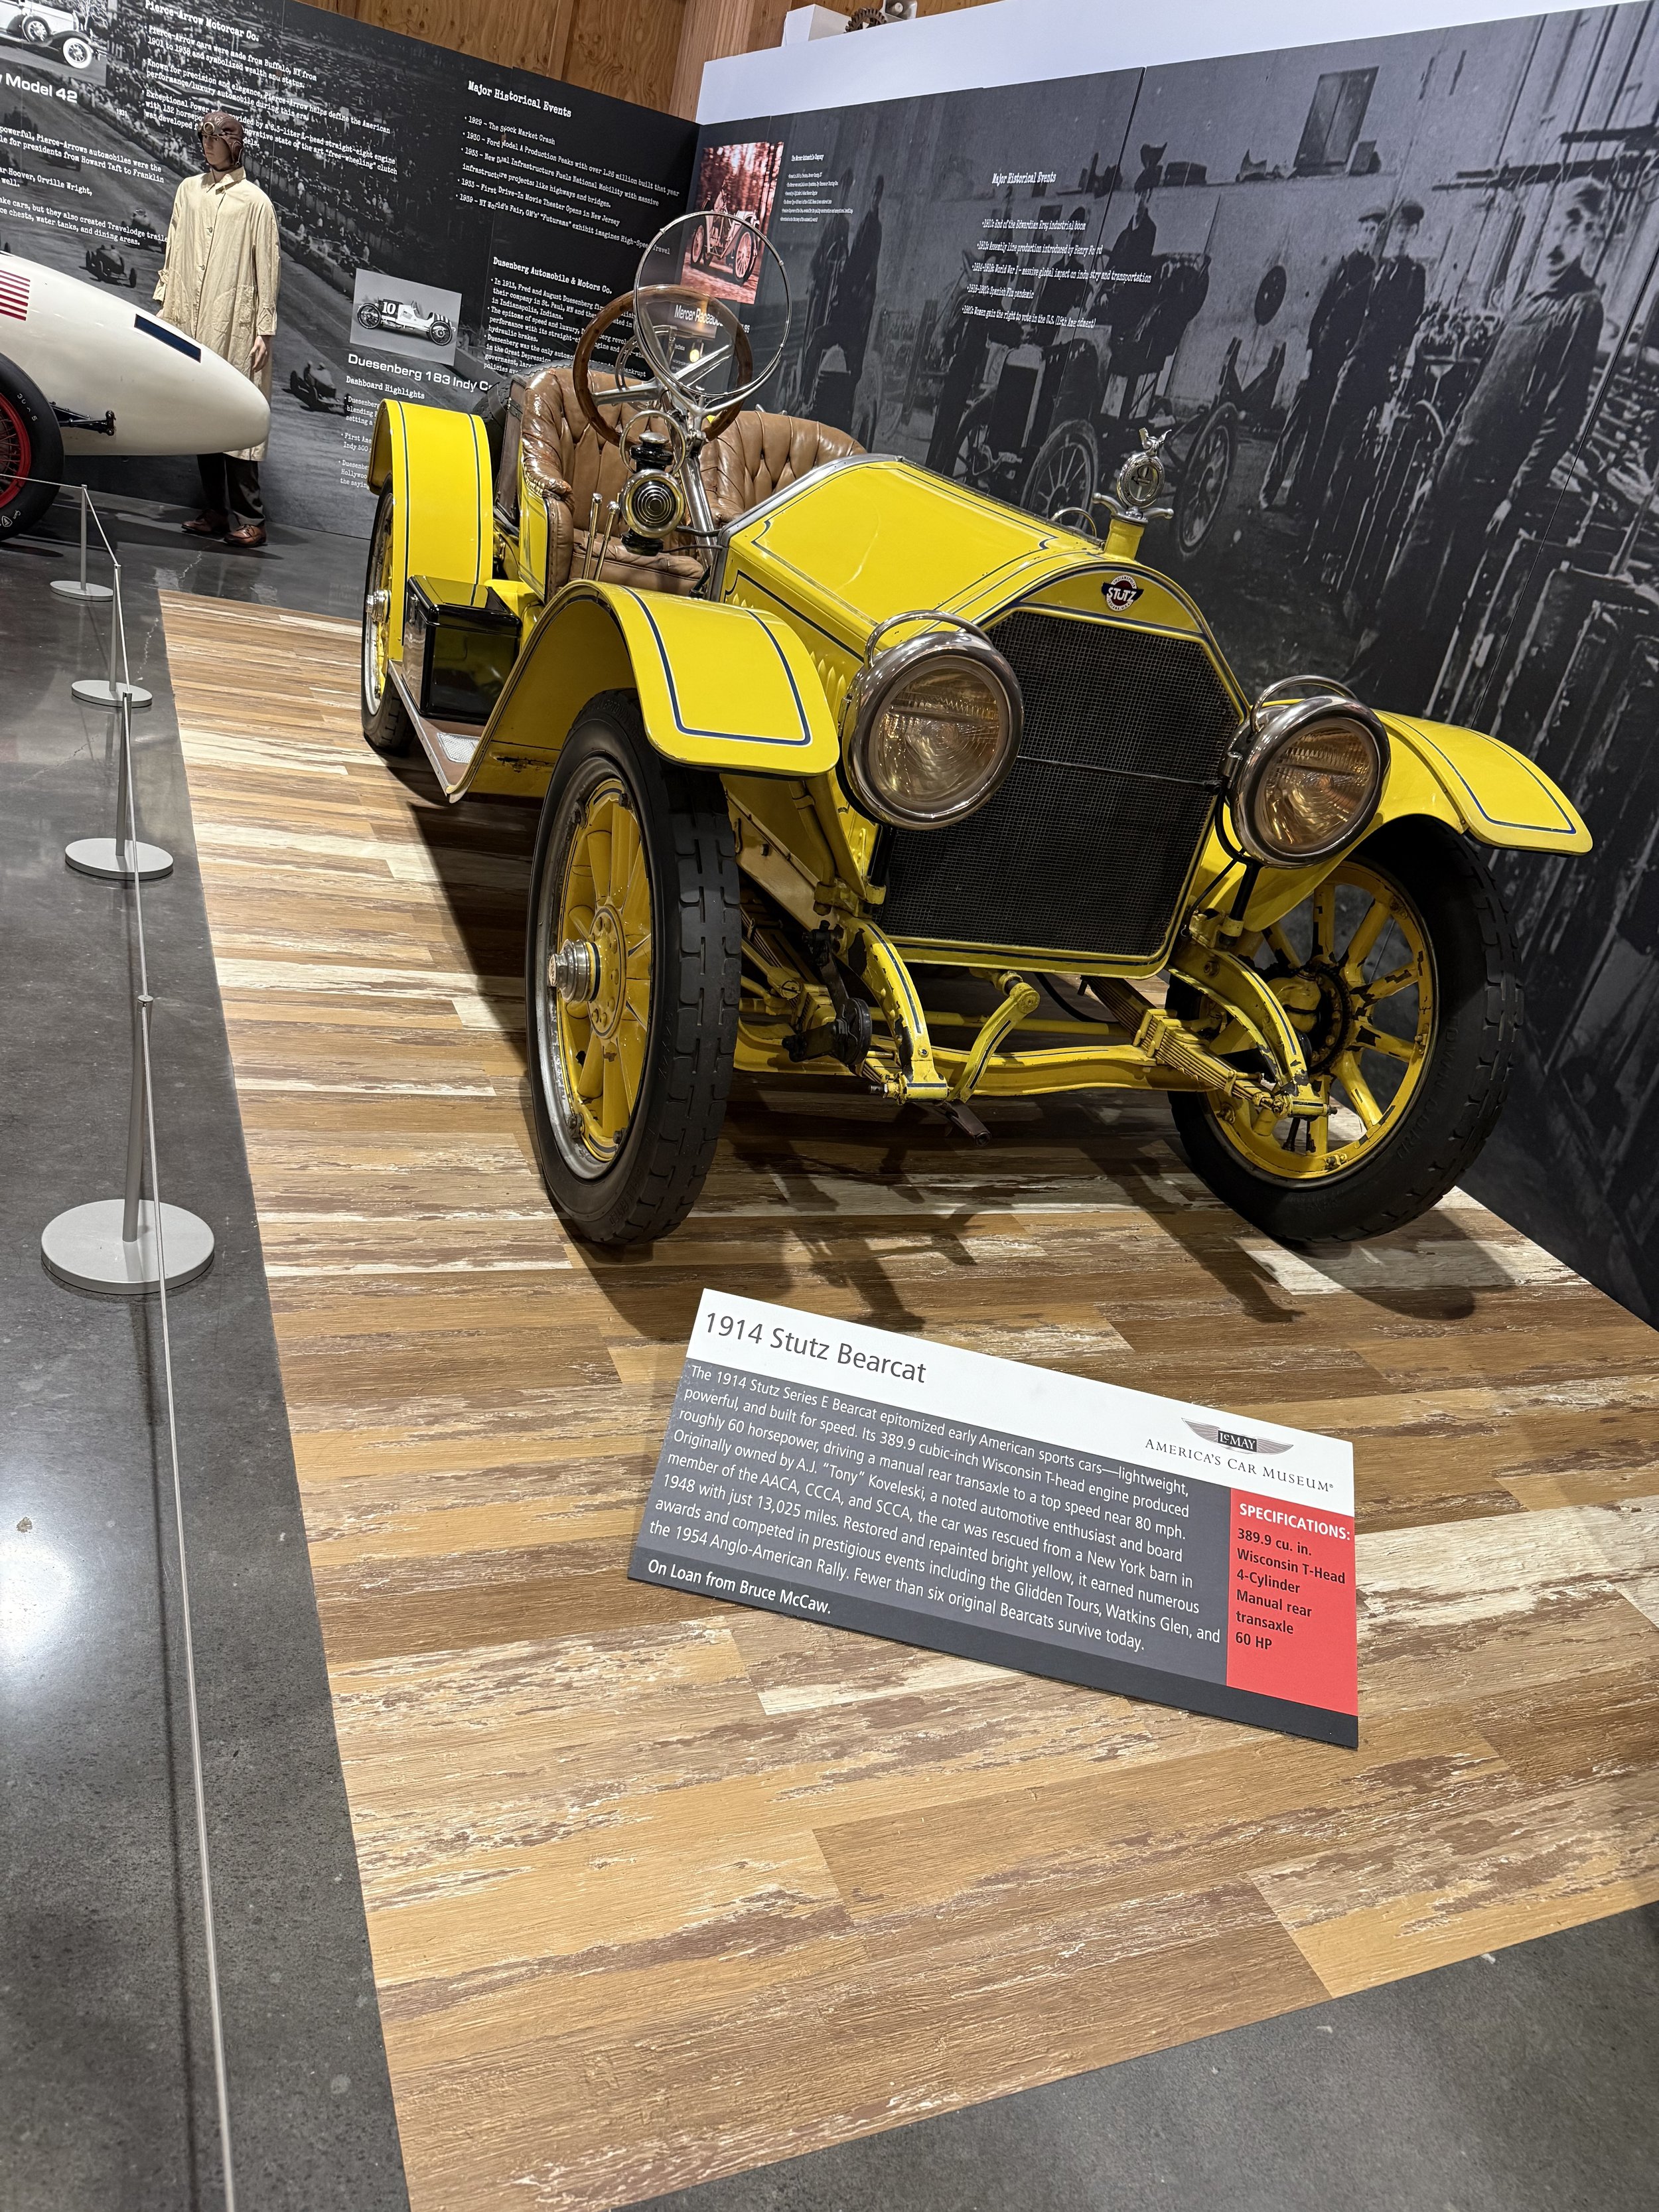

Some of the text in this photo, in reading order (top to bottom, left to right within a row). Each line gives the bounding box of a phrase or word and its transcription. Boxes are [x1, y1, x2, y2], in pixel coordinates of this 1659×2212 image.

[145, 0, 259, 42] Pierce-Arrow Motorcar Co.
[5, 72, 78, 104] Model 42
[467, 80, 571, 117] Major Historical Events
[468, 115, 482, 125] 1929
[488, 121, 499, 131] The
[518, 127, 538, 140] Market
[539, 133, 555, 145] Crash
[9, 137, 164, 183] for presidents from Howard Taft to Franklin
[36, 133, 88, 153] Pierce-Arrows
[88, 149, 131, 165] automobiles
[132, 160, 149, 169] were
[150, 163, 161, 173] the
[991, 171, 1056, 186] Major Historical Events
[492, 256, 530, 275] Dusenberg
[530, 266, 569, 283] Automobile
[577, 278, 601, 291] Motors
[601, 285, 612, 294] Co.
[382, 301, 396, 315] 10
[674, 305, 695, 321] Mercer
[345, 375, 425, 399] Dashboard Highlights
[348, 353, 477, 393] Duesenberg 183 Indy
[1106, 587, 1137, 603] STUTZ
[707, 1312, 926, 1383] 1914 Stutz Bearcat
[691, 1364, 711, 1381] The
[717, 1370, 747, 1389] 1914
[749, 1378, 780, 1396] Stutz
[782, 1386, 818, 1406] Series
[821, 1395, 829, 1408] E
[831, 1398, 877, 1420] Bearcat
[880, 1412, 945, 1436] epitomized
[948, 1428, 977, 1446] early
[978, 1434, 1035, 1457] American
[1038, 1450, 1074, 1467] sports
[684, 1386, 1189, 1517] powerful, and built for speed. Its 389.9 cubic-inch Wisconsin T-head engine produced
[1227, 1458, 1256, 1475] CAR
[674, 1429, 732, 1456] Originally
[734, 1445, 777, 1463] owned
[779, 1451, 795, 1471] by
[795, 1457, 817, 1474] A.J.
[868, 1473, 926, 1502] Koveleski,
[930, 1492, 938, 1503] a
[941, 1495, 977, 1512] noted
[980, 1504, 1049, 1530] automotive
[1052, 1522, 1116, 1546] enthusiast
[1119, 1538, 1143, 1552] and
[1147, 1540, 1182, 1562] board
[1240, 1503, 1350, 1540] SPECIFICATIONS:
[1237, 1527, 1311, 1556] 389.9 cu. in.
[1236, 1568, 1300, 1593] 4-Cylinder
[1237, 1547, 1345, 1584] Wisconsin T-Head
[648, 1559, 830, 1614] On Loan from Bruce McCaw.
[649, 1519, 1144, 1653] the 1954 Anglo-American Rally. Fewer than six original Bearcats survive today.
[1236, 1589, 1312, 1617] Manual rear
[1235, 1631, 1272, 1650] 60 HP
[1236, 1610, 1293, 1634] transaxle
